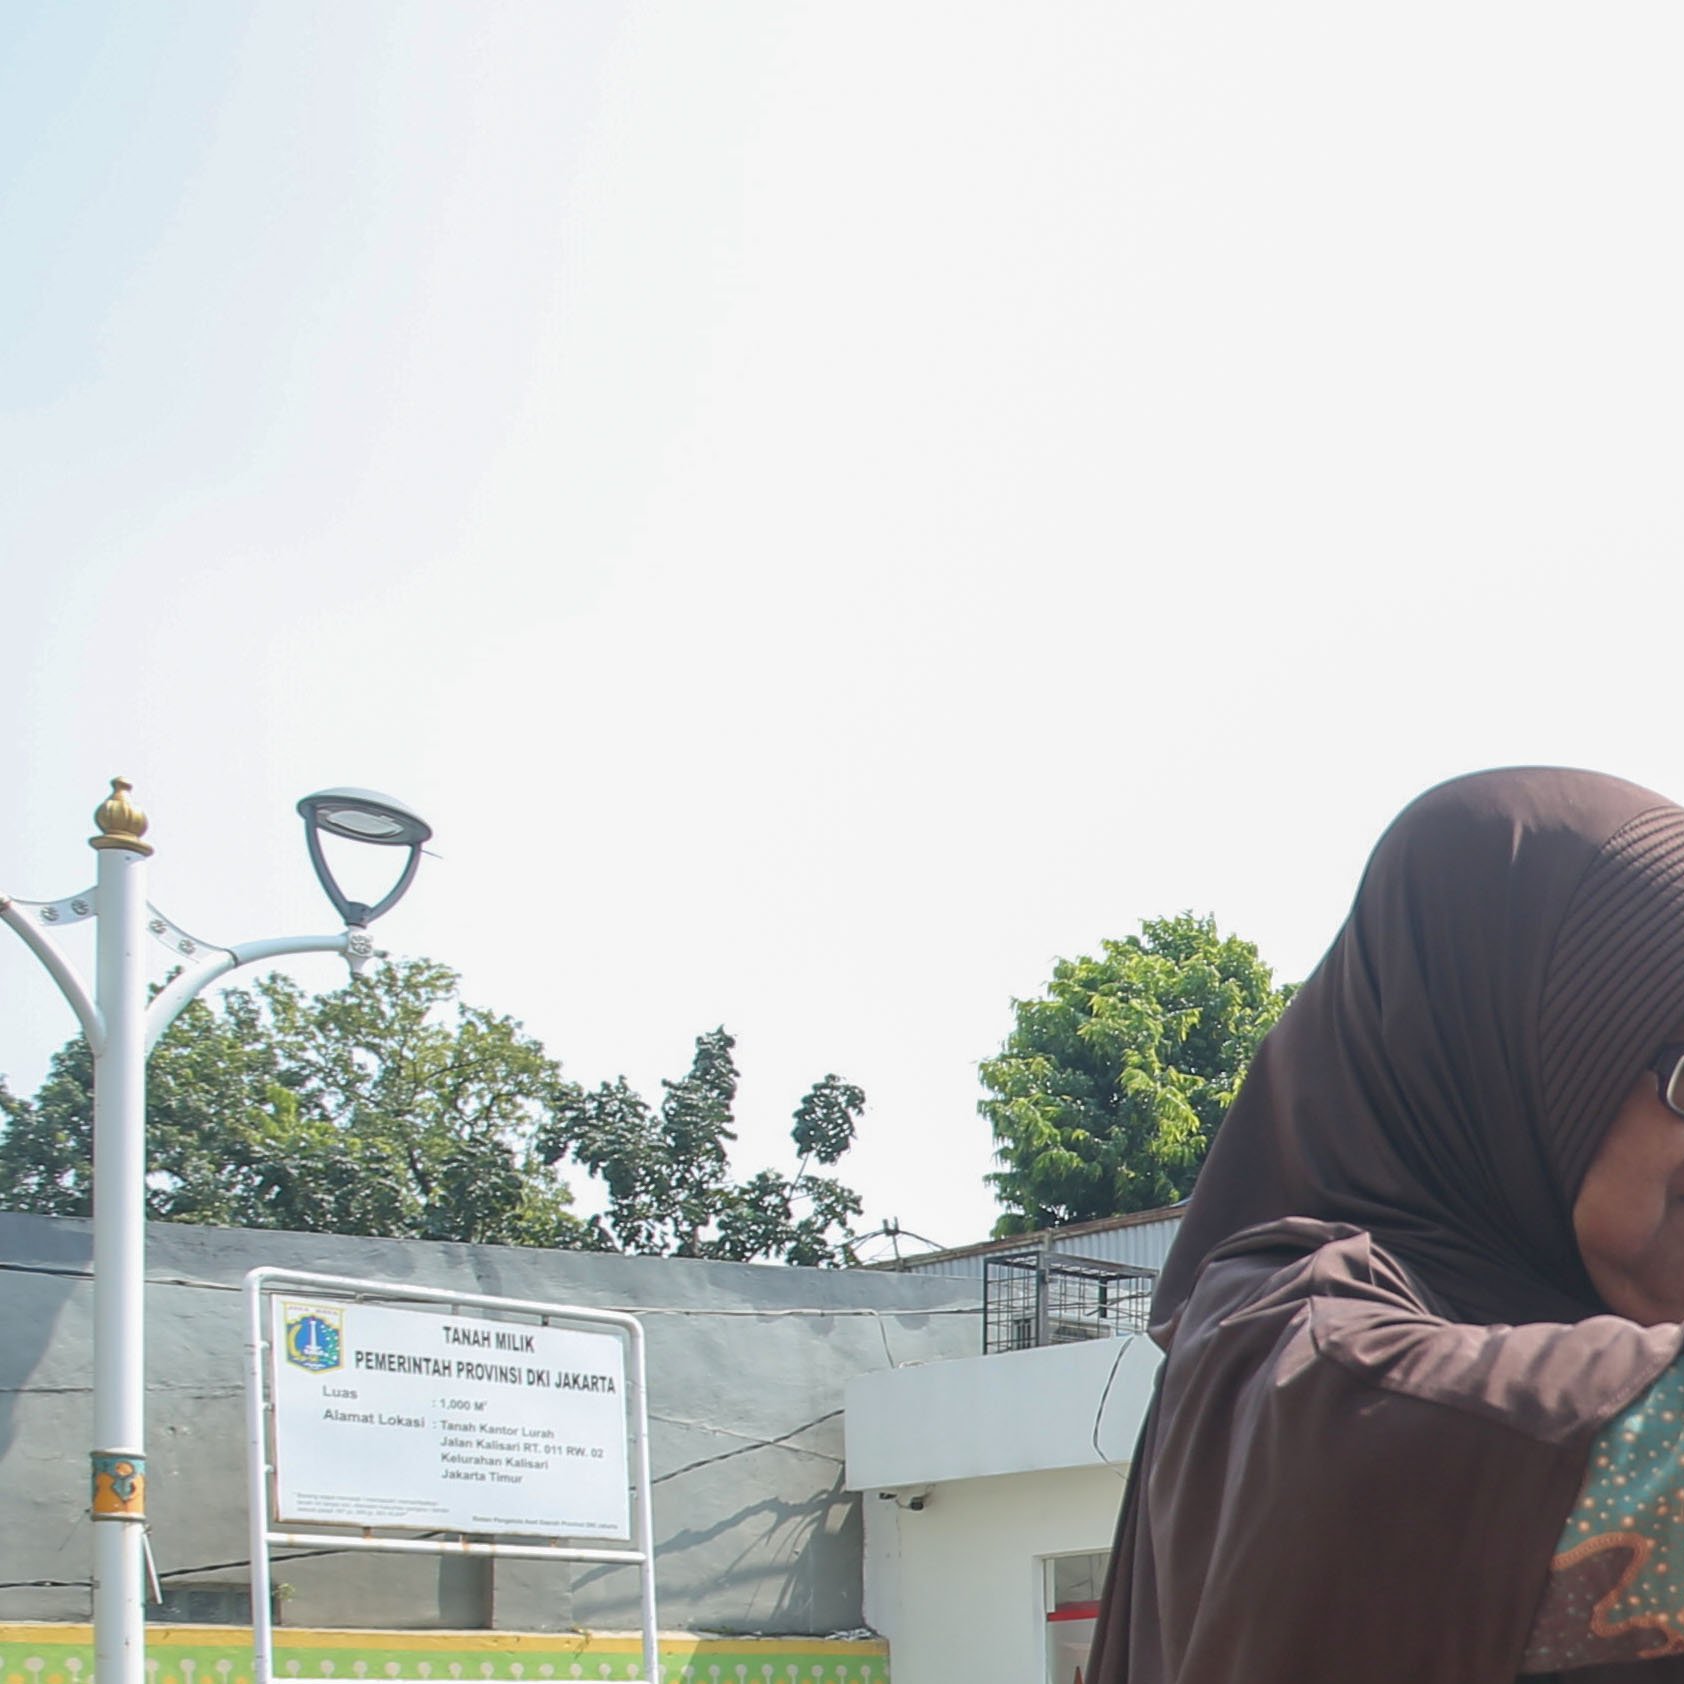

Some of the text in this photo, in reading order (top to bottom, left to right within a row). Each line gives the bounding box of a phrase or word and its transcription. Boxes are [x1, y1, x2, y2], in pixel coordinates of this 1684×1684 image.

[444, 1326, 536, 1353] TANAH MILIK
[355, 1350, 617, 1394] PEMERINTAH PROVINSI DKI JAKARTA
[322, 1385, 358, 1400] Luas
[323, 1409, 375, 1425] Alamat
[379, 1414, 425, 1428] Lokasi
[440, 1420, 476, 1433] Tanah
[479, 1423, 518, 1436] Kantor
[522, 1427, 555, 1439] Lurah
[440, 1437, 473, 1449] Jalan
[476, 1439, 521, 1452] Kalisari
[441, 1453, 549, 1470] Kelurahan Kalisari
[441, 1469, 523, 1484] Jakarta Timur
